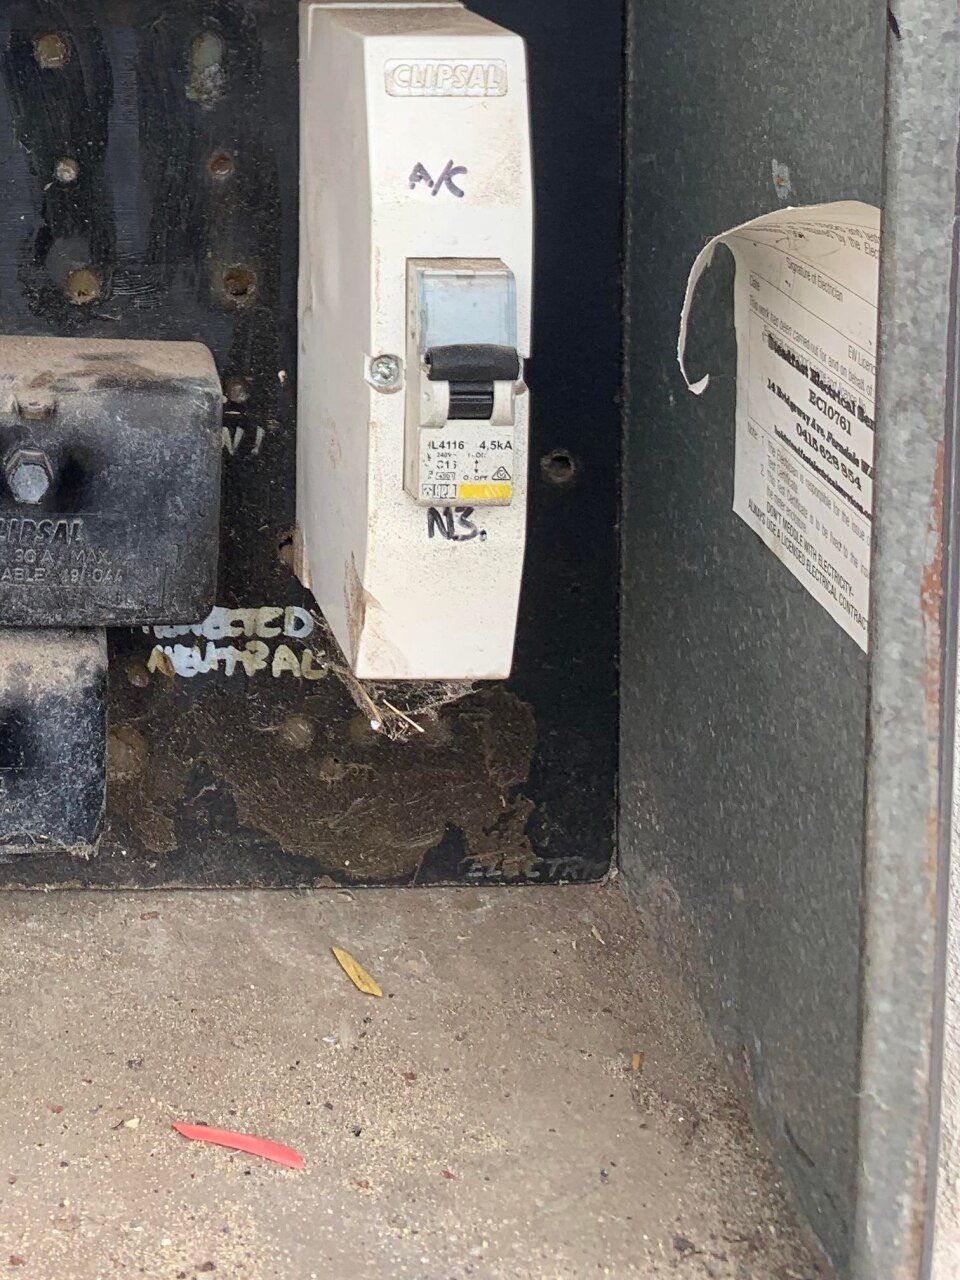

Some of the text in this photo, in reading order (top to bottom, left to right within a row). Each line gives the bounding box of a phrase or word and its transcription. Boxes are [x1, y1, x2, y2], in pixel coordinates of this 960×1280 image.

[391, 62, 501, 90] CLIPSAL
[408, 160, 468, 199] A/C
[816, 274, 843, 302] Electrician
[767, 378, 775, 392] 14
[808, 388, 852, 435] EC10761
[803, 538, 817, 561] WITH
[804, 556, 838, 601] ELECTRICAL
[147, 640, 328, 680] NEUTRAL
